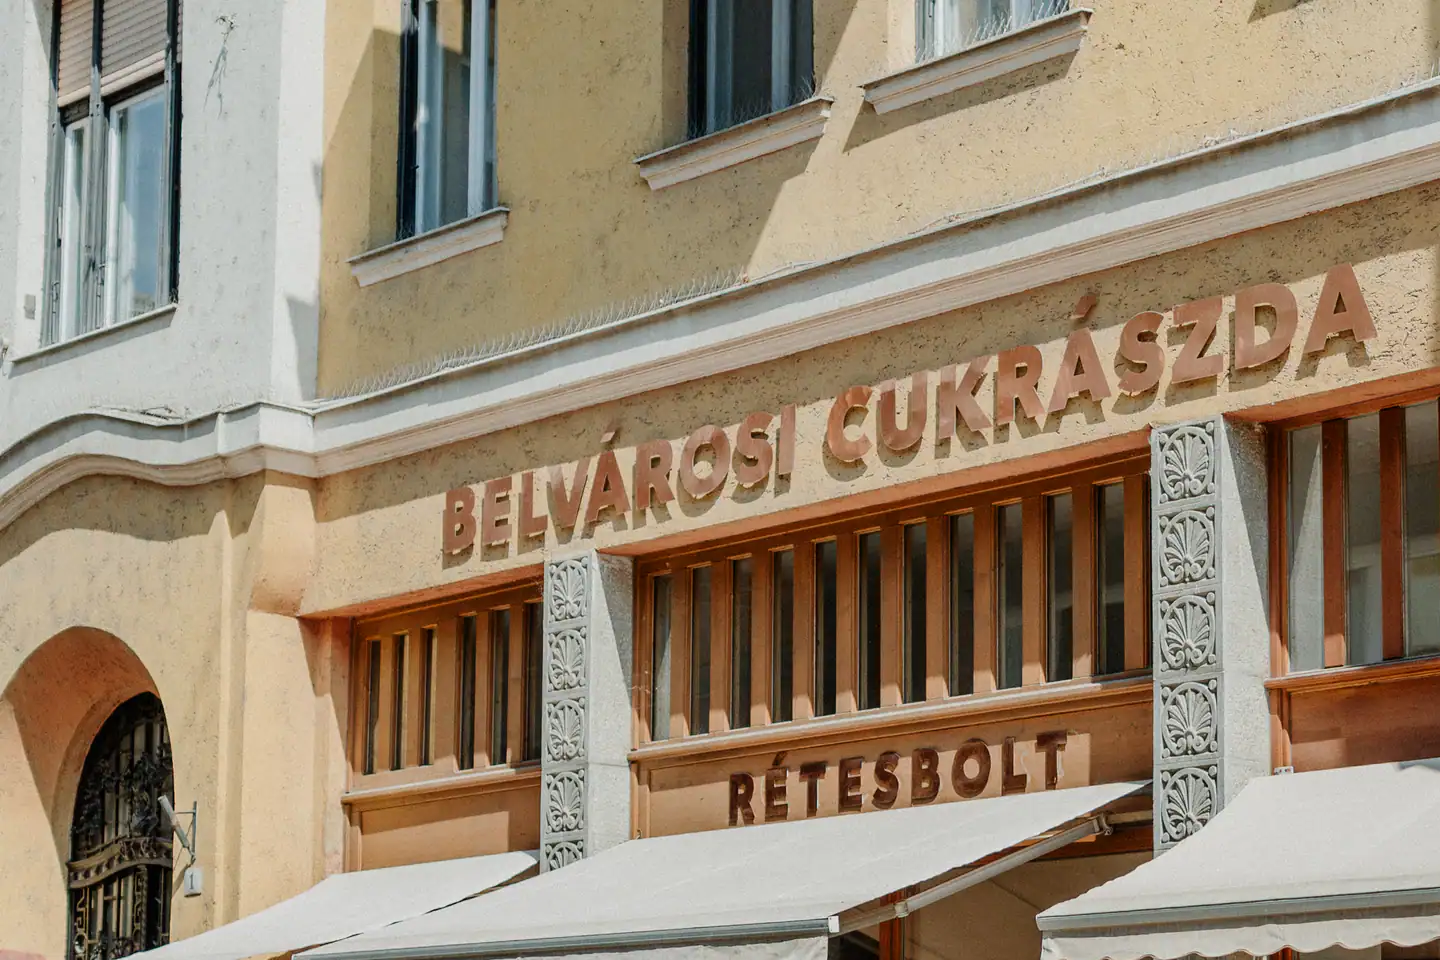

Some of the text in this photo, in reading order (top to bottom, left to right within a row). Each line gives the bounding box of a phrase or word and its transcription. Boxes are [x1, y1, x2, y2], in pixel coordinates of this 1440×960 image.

[442, 263, 1379, 556] BELVÁROSI CUKRÁSZDA
[728, 729, 1070, 828] RÉTESBOLT
[189, 871, 195, 890] 1
